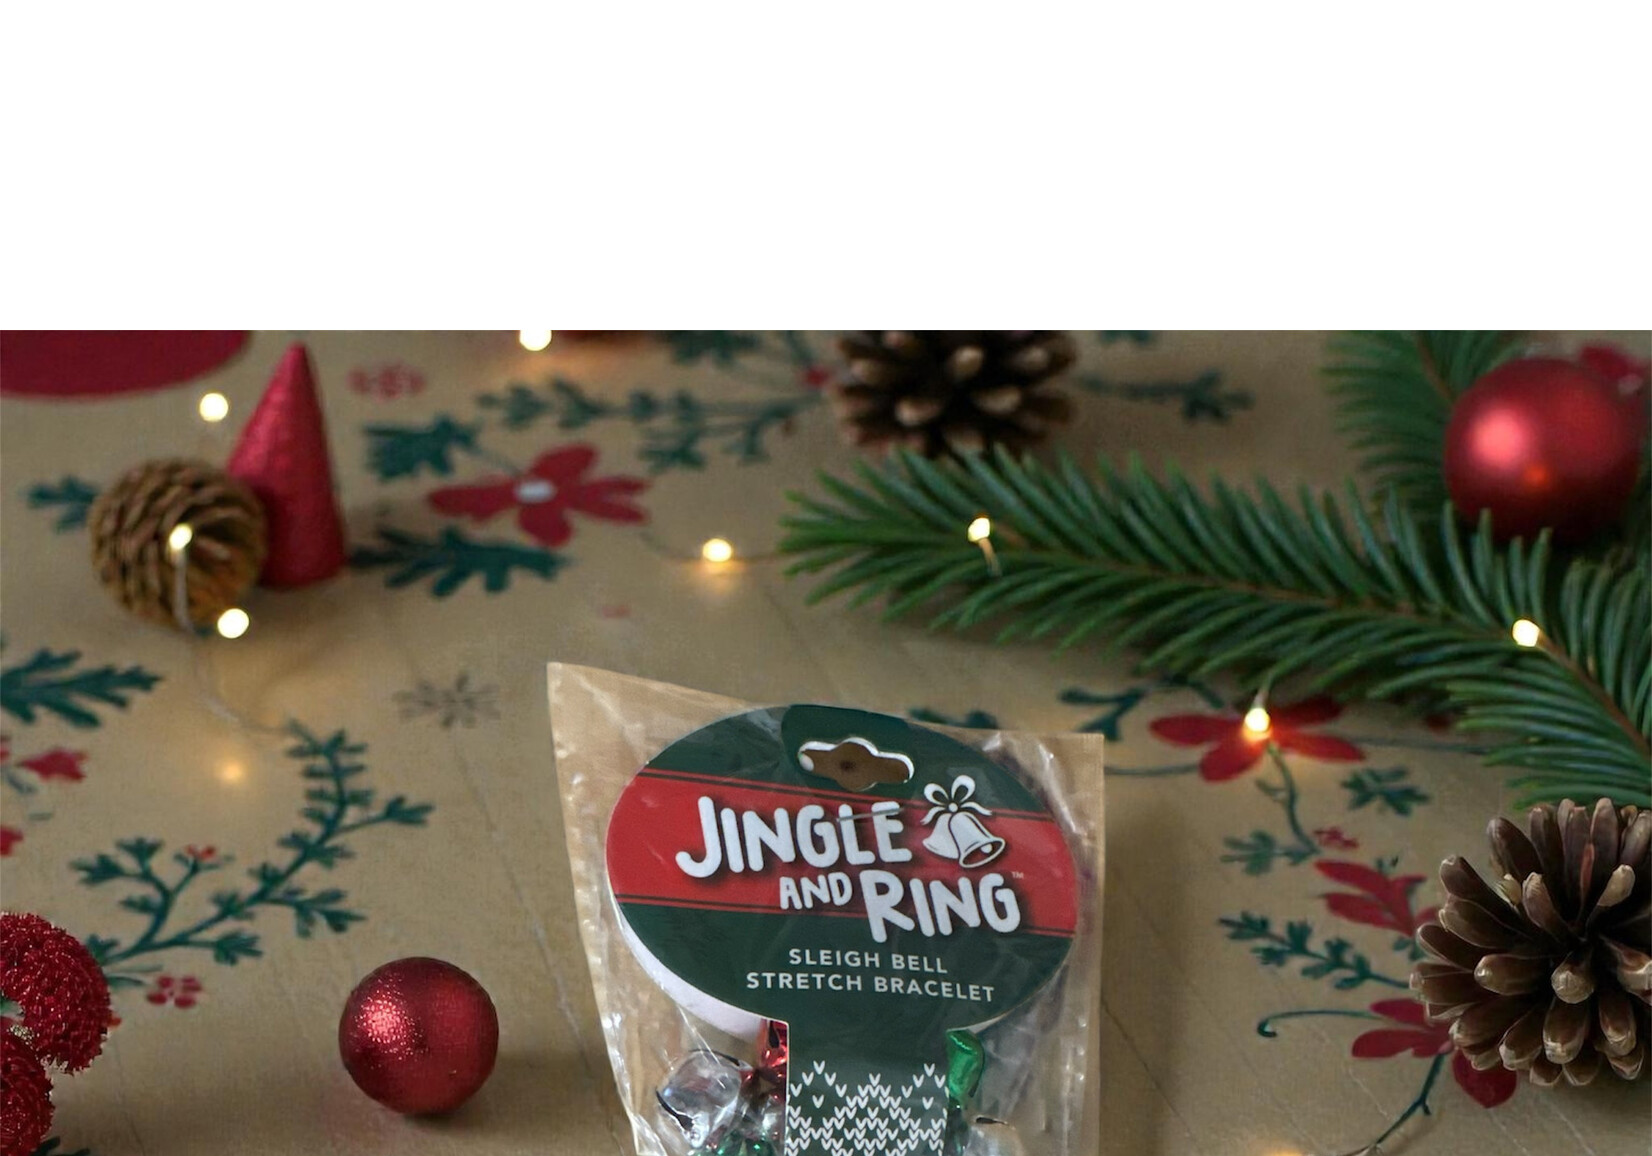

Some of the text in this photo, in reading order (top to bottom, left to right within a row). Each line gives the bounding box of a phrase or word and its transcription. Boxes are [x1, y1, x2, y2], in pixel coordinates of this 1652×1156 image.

[675, 796, 913, 878] JINGLE
[779, 872, 853, 910] AND
[860, 869, 1021, 943] RING
[789, 948, 948, 973] SLEIGH BELL
[746, 972, 995, 1002] STRETCH BRACELET
